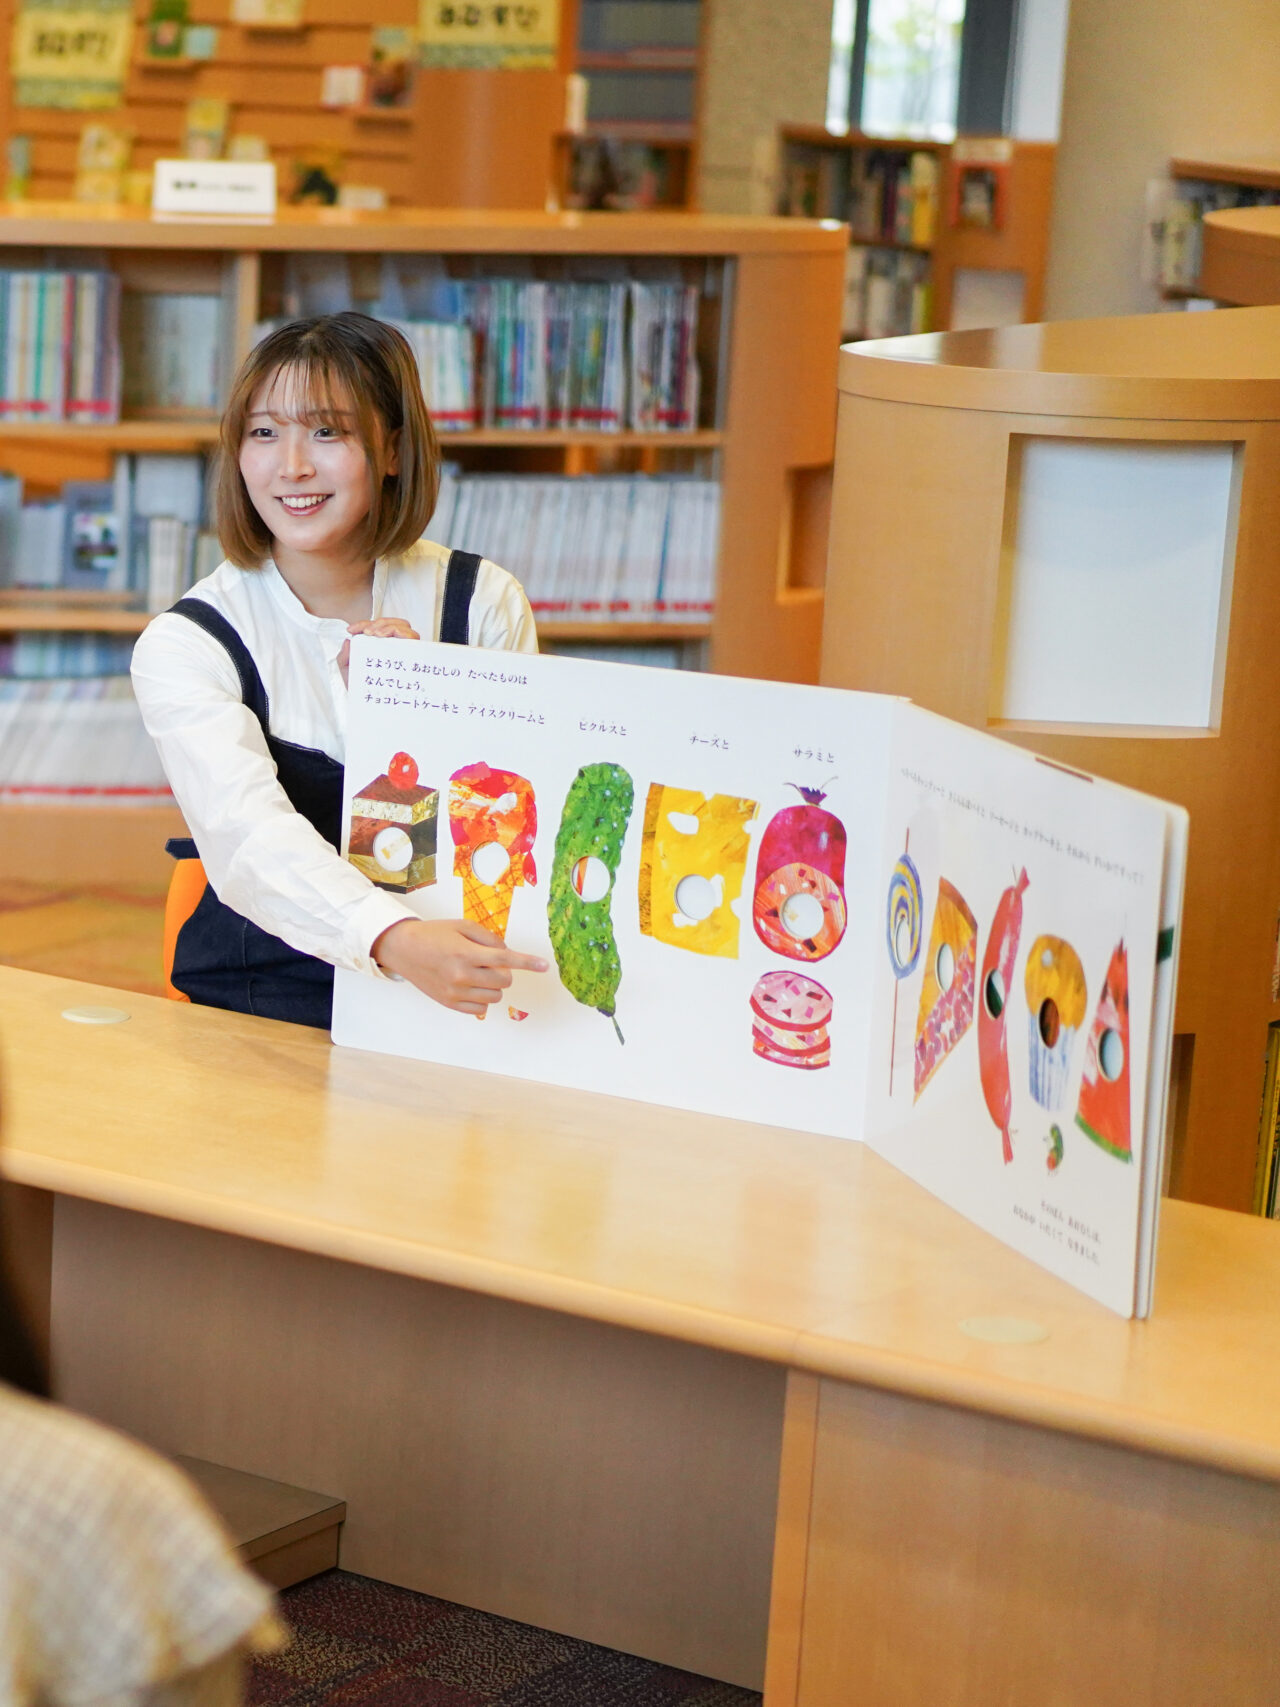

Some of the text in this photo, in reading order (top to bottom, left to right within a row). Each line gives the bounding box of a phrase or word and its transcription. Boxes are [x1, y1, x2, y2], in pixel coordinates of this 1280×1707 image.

[365, 657, 529, 686] どようび、 あおむしの たべたものは
[365, 675, 426, 693] なんでしょう。
[365, 692, 546, 726] チョコレートケーキと アイスクリームと
[578, 719, 628, 737] ピクルスと
[689, 734, 730, 750] チーズと
[793, 747, 836, 764] サラミと
